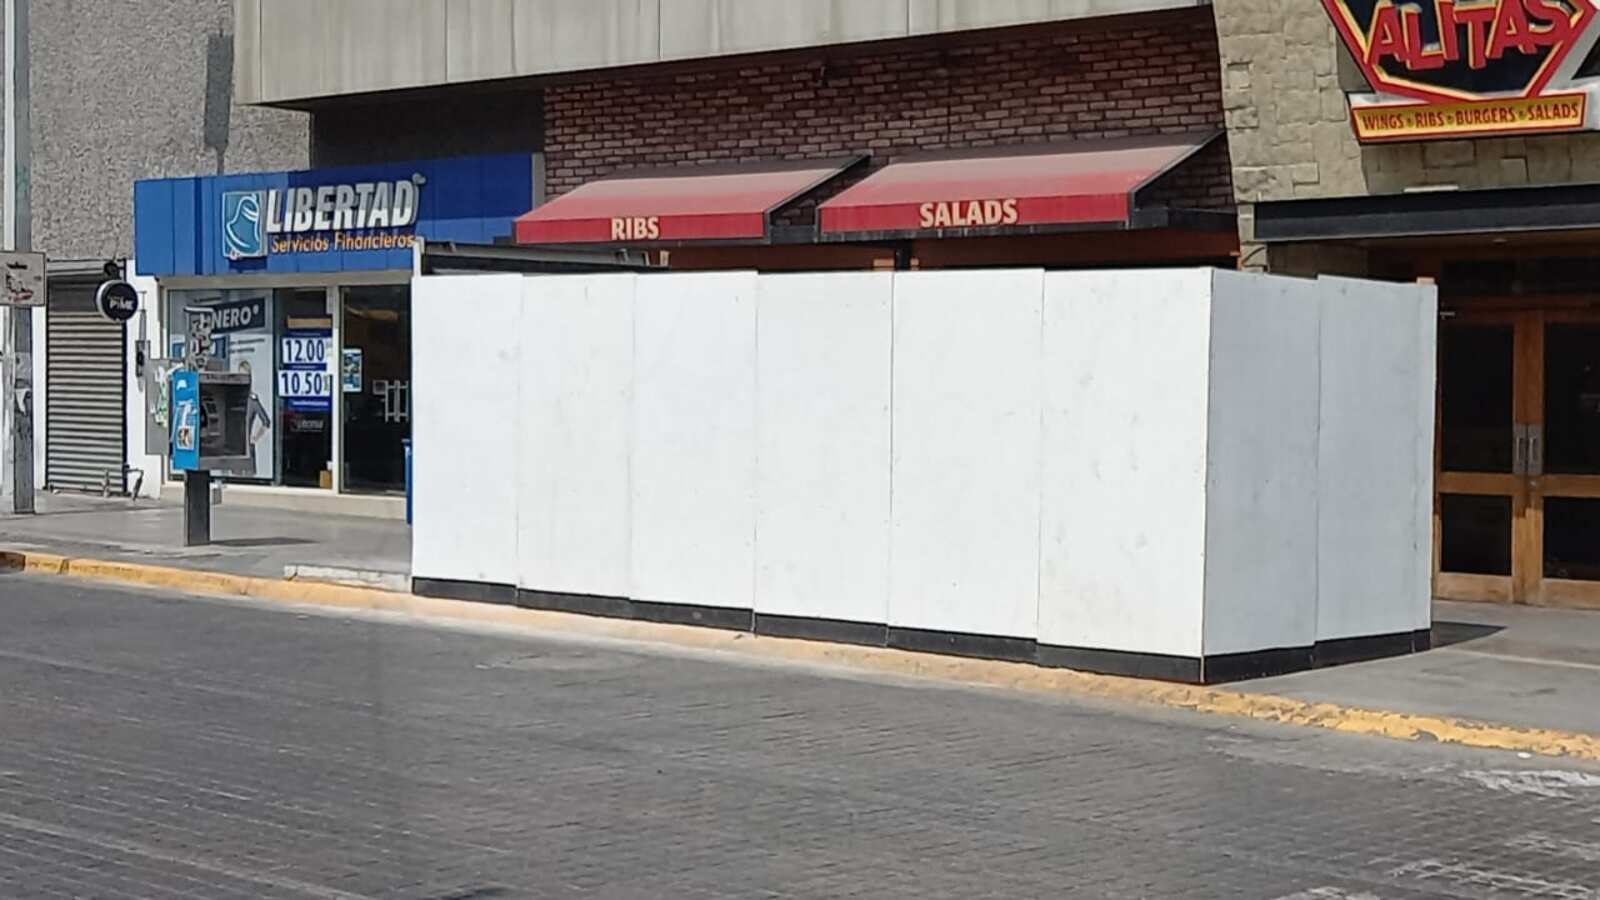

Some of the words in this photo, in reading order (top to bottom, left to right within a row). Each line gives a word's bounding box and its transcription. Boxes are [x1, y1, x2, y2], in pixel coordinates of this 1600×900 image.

[1365, 0, 1576, 70] ALITAS
[1362, 114, 1405, 130] WINGS
[1415, 111, 1445, 127] RIBS
[1455, 107, 1515, 125] BURGERS
[1527, 103, 1579, 120] SALADS
[266, 180, 418, 233] LIBERTAD
[920, 198, 1018, 228] SALADS
[611, 216, 660, 241] RIBS
[271, 235, 329, 253] Servicios
[334, 231, 415, 250] Financieros
[286, 339, 325, 362] 12.00
[281, 372, 322, 395] 10.50
